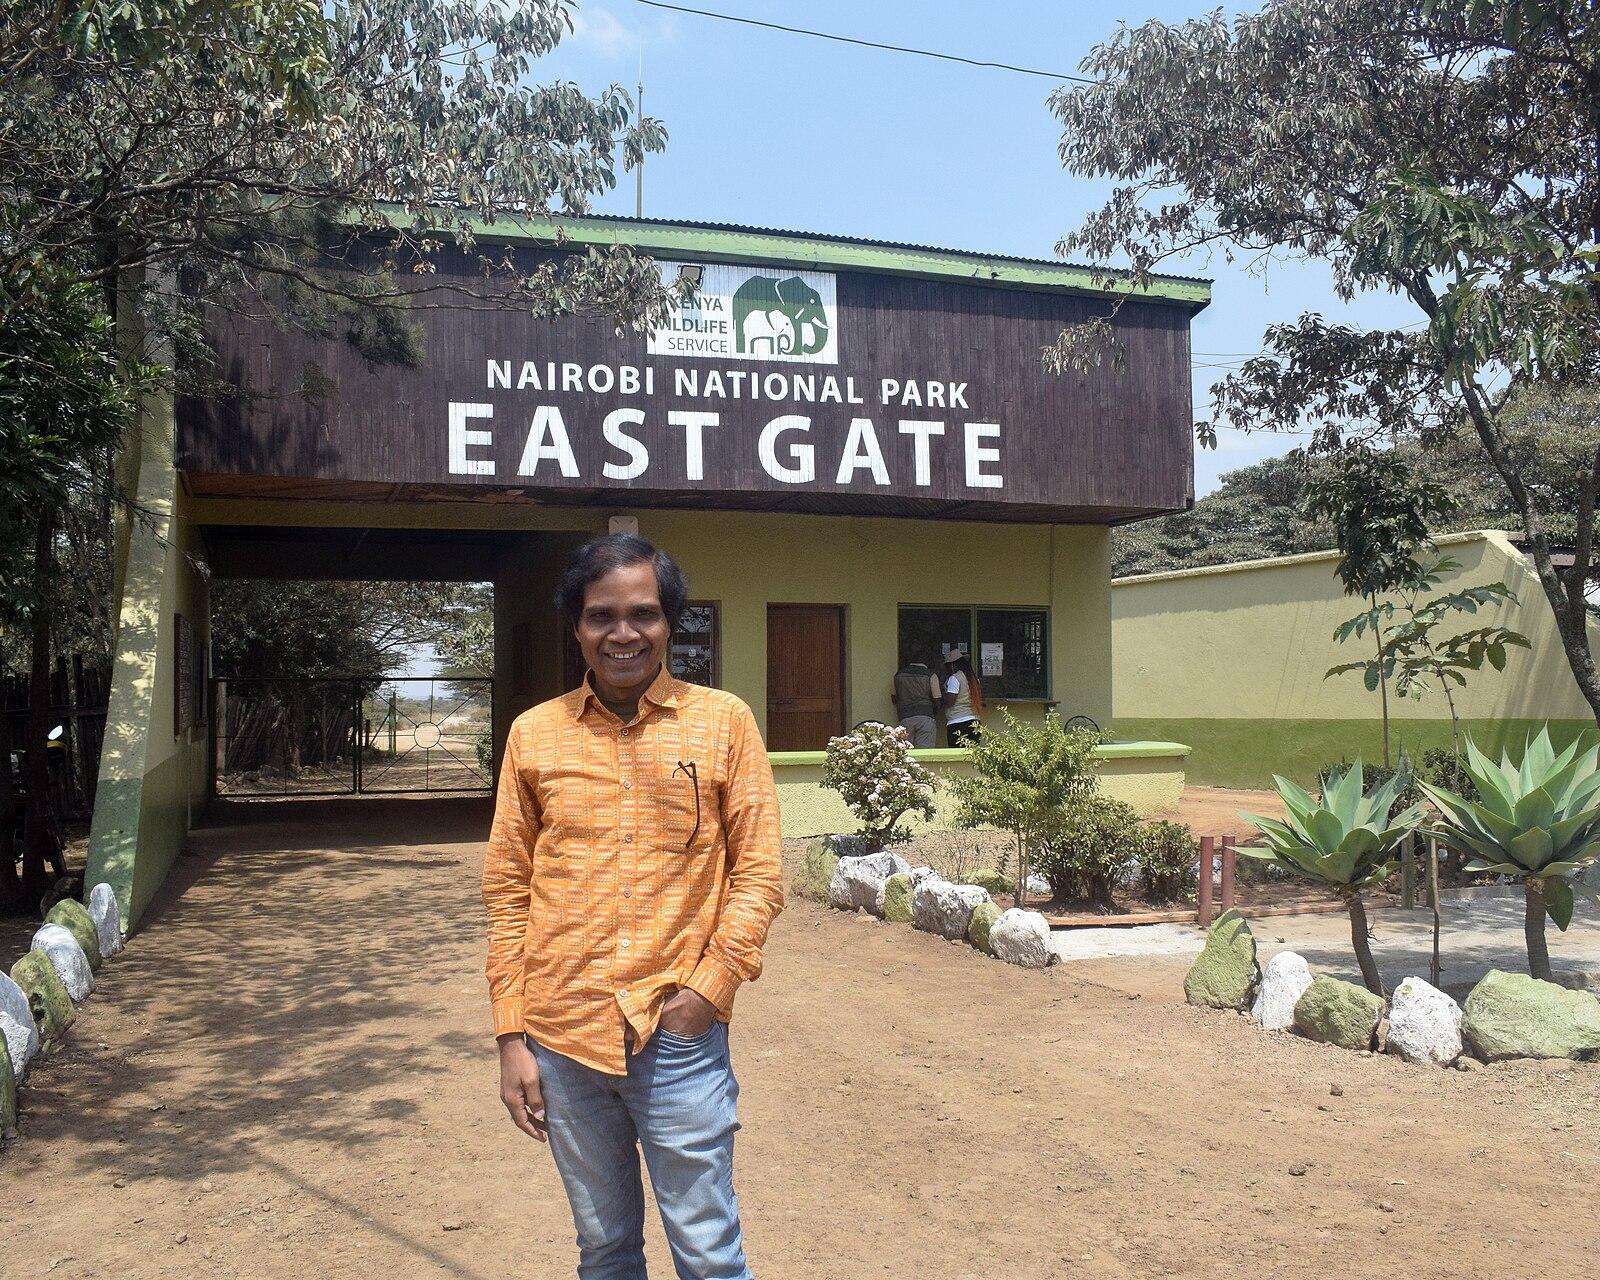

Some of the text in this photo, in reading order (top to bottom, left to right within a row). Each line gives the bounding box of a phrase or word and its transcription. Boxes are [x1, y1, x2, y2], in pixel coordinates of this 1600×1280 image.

[668, 337, 727, 353] SERVICE
[487, 359, 969, 409] NAIROBI NATIONAL PARK
[448, 401, 1004, 489] EAST GATE
